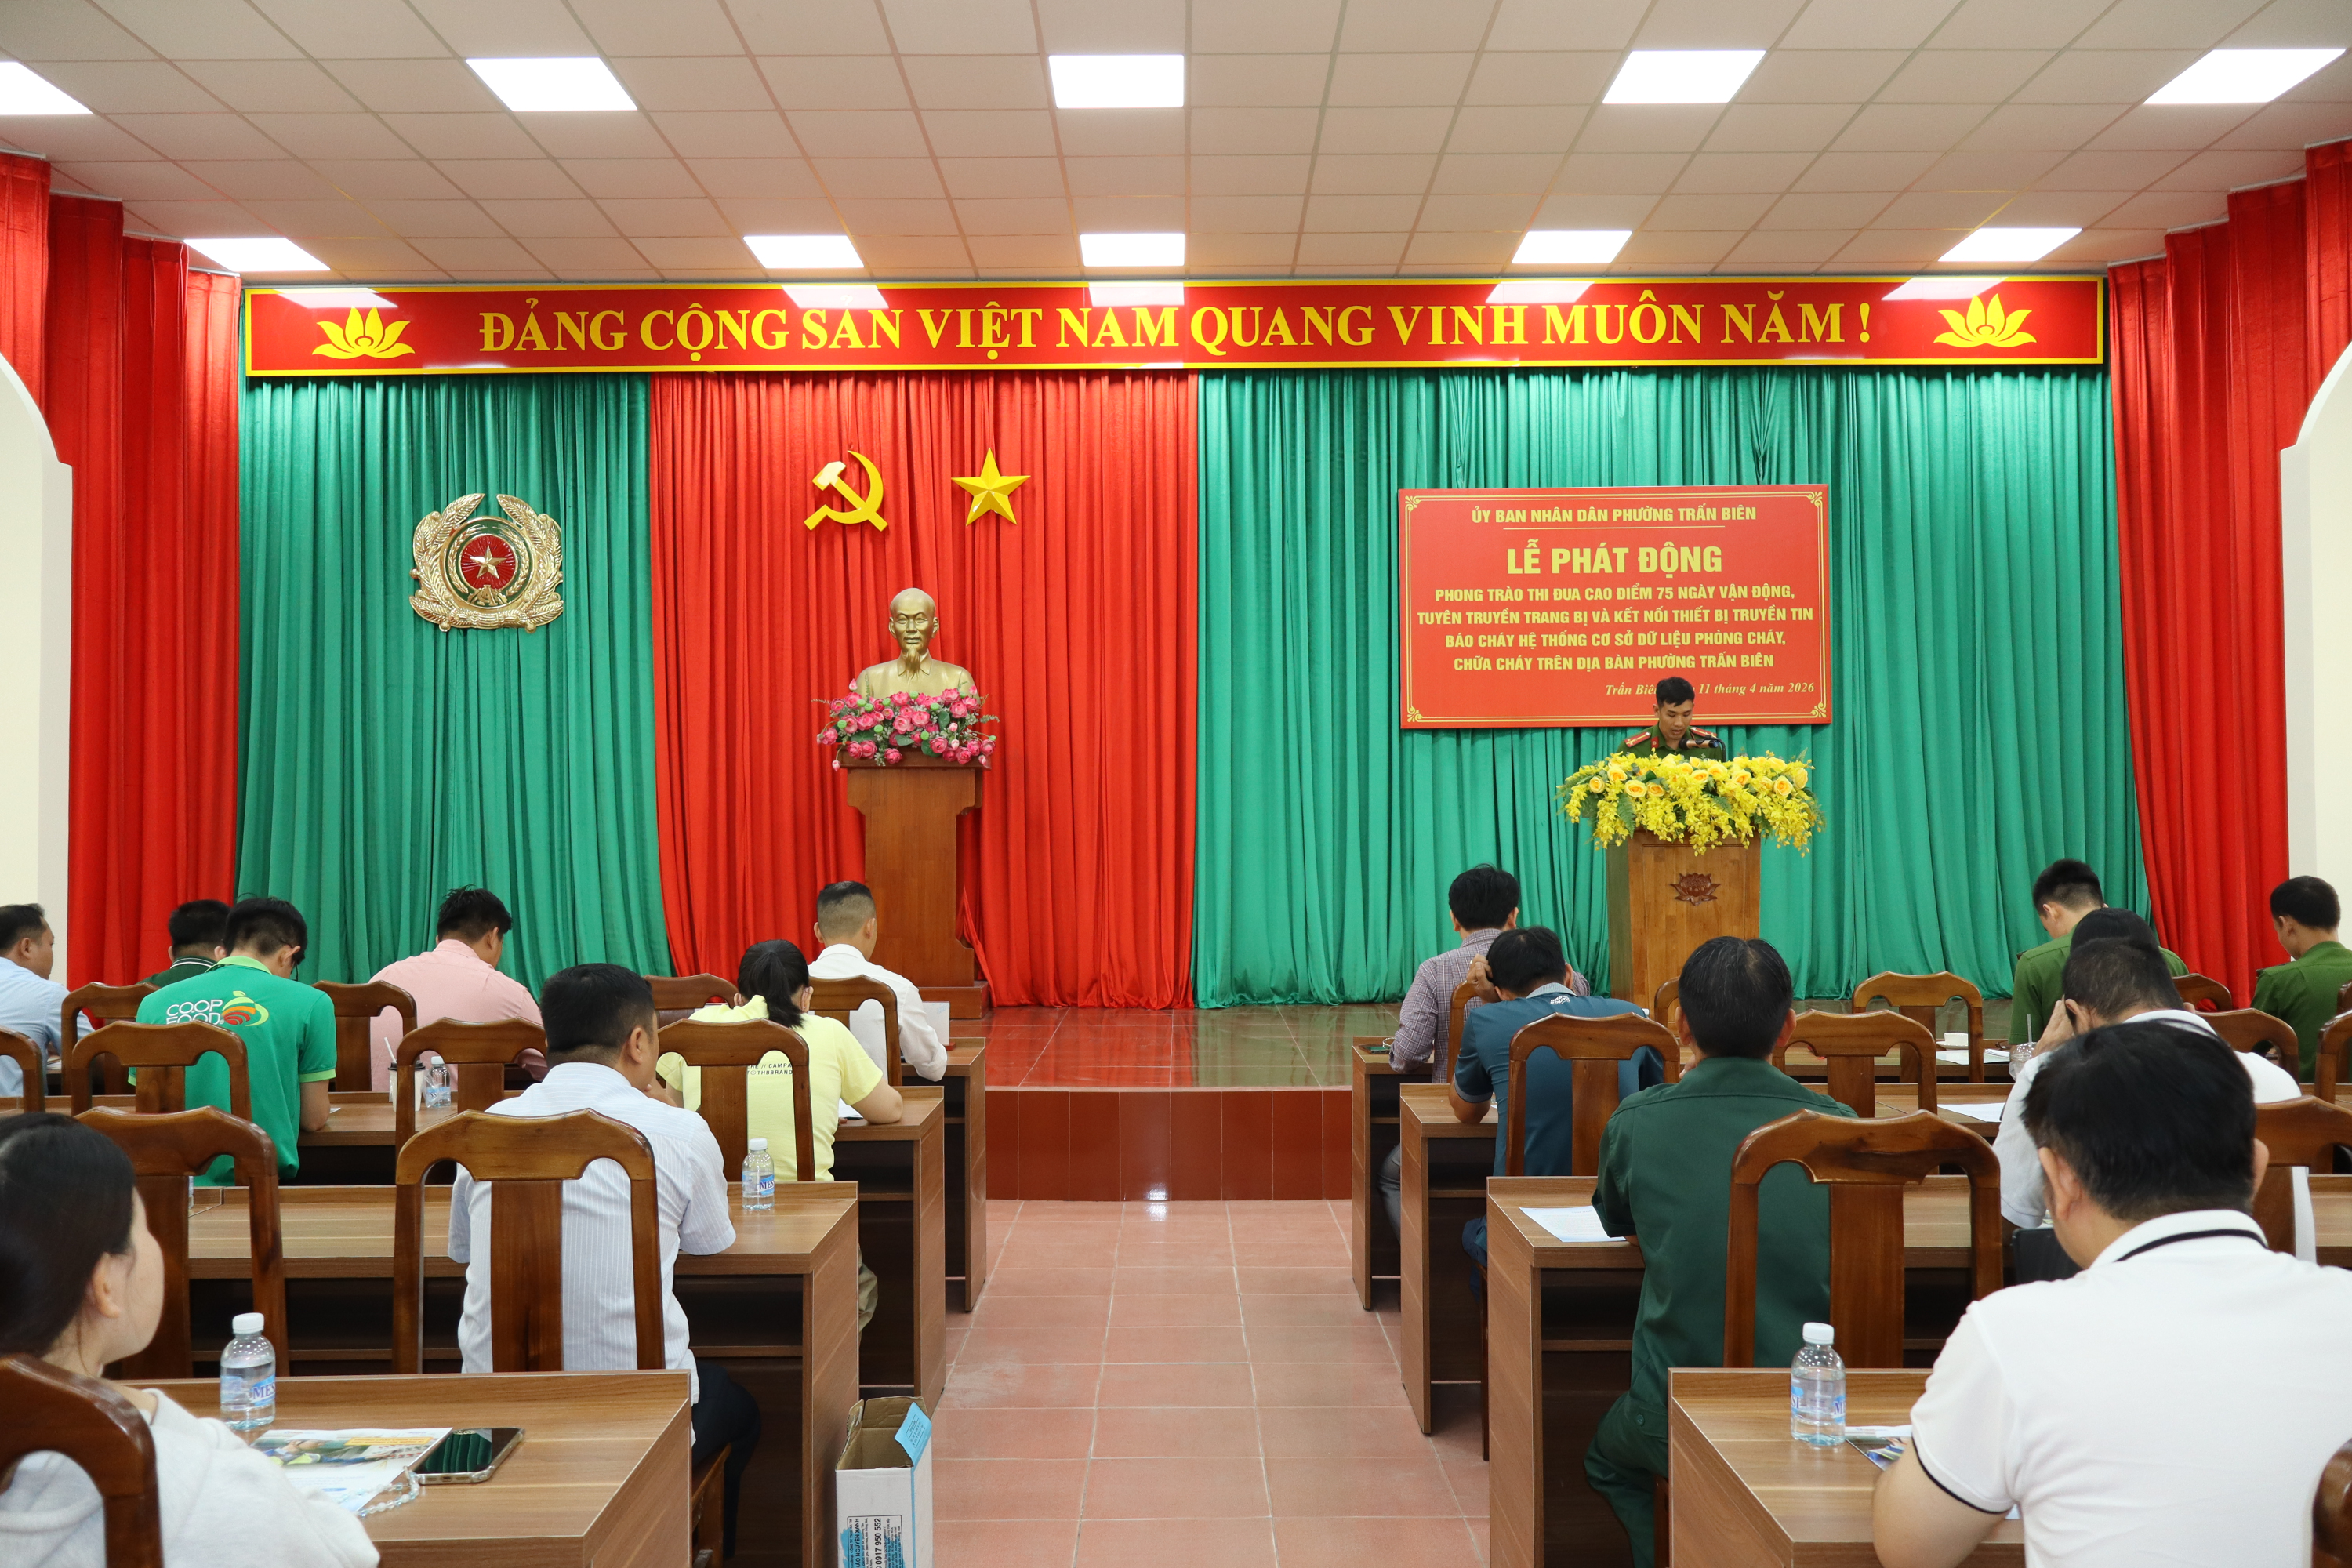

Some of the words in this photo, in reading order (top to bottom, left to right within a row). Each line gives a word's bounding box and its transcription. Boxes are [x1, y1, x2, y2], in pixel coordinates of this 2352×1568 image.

[479, 298, 627, 352] ĐẢNG
[639, 302, 790, 362] CỘNG
[916, 302, 1042, 360] VIỆT
[1056, 307, 1179, 349] NAM
[1190, 306, 1375, 356] QUANG
[1388, 305, 1530, 347] VINH
[1541, 289, 1704, 345] MUÔN
[1722, 290, 1845, 343] NĂM
[1859, 304, 1870, 343] !
[1472, 505, 1491, 524] ỦY
[1495, 509, 1526, 523] BAN
[1530, 506, 1573, 523] NHÂN
[1577, 506, 1609, 523] DÂN
[1612, 505, 1674, 522] PHƯỜNG
[1677, 503, 1717, 521] TRẤN
[1721, 504, 1757, 521] BIÊN
[1507, 538, 1541, 575] LỄ
[1551, 542, 1630, 574] PHÁT
[1637, 541, 1722, 579] ĐỘNG
[1435, 588, 1484, 602] PHONG
[1486, 586, 1524, 601] TRÀO
[1526, 588, 1549, 601] THI
[1552, 587, 1581, 601] ĐUA
[1584, 587, 1613, 601] CAO
[1616, 583, 1653, 601] ĐIỂM
[1656, 586, 1674, 600] 75
[1677, 583, 1716, 600] NGÀY
[1719, 583, 1748, 601] VẬN
[1751, 583, 1795, 601] ĐỘNG,
[1417, 609, 1462, 625] TUYÊN
[1465, 608, 1520, 625] TRUYỀN
[1523, 610, 1570, 624] TRANG
[1573, 610, 1588, 626] BỊ
[1591, 608, 1610, 623] VÀ
[1613, 606, 1640, 623] KẾT
[1643, 605, 1668, 623] NỐI
[1671, 605, 1711, 622] THIẾT
[1714, 608, 1729, 625] BỊ
[1732, 604, 1787, 622] TRUYỀN
[1790, 608, 1813, 621] TIN
[1445, 632, 1474, 648] BÁO
[1477, 632, 1515, 648] CHÁY
[1519, 631, 1537, 650] HỆ
[1540, 630, 1588, 647] THỐNG
[1591, 632, 1611, 647] CƠ
[1614, 629, 1634, 647] SỞ
[1637, 630, 1658, 646] DỮ
[1660, 630, 1691, 648] LIỆU
[1694, 629, 1744, 645] PHÒNG
[1747, 628, 1786, 646] CHÁY,
[1454, 655, 1493, 671] CHỮA
[1495, 655, 1534, 671] CHÁY
[1536, 654, 1573, 670] TRÊN
[1576, 656, 1601, 673] ĐỊA
[1604, 654, 1635, 670] BÀN
[1638, 652, 1696, 670] PHƯỜNG
[1699, 651, 1737, 669] TRẤN
[1740, 652, 1774, 668] BIÊN
[1606, 681, 1632, 695] Trấn
[1698, 684, 1711, 695] 11
[1714, 683, 1747, 696] tháng
[1749, 684, 1757, 694] 4
[1759, 683, 1784, 694] năm
[1787, 681, 1815, 693] 2026
[874, 1548, 883, 1565] 0917
